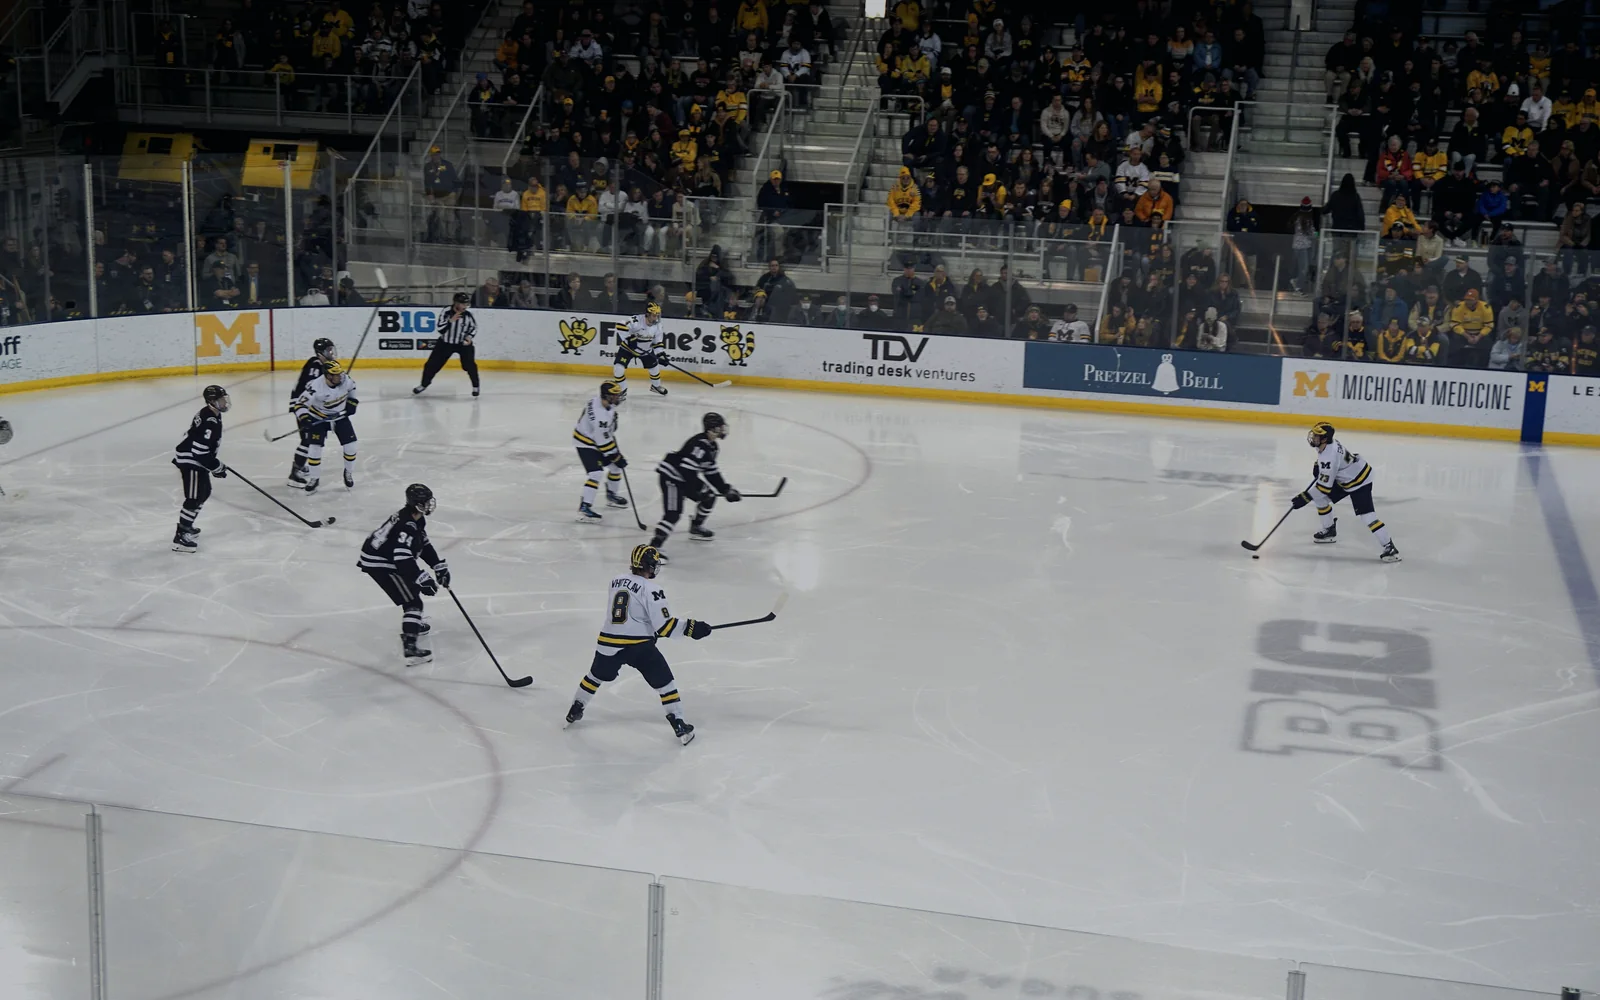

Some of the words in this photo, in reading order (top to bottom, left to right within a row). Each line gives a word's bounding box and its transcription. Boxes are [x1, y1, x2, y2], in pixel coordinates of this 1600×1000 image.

[196, 312, 261, 357] M
[1057, 329, 1075, 341] M
[863, 333, 930, 363] TDV
[600, 350, 618, 358] Pes
[701, 357, 717, 365] Inc.
[822, 361, 874, 377] trading
[877, 363, 912, 378] desk
[915, 368, 976, 382] ventures
[1083, 363, 1151, 385] PRETZEL
[1181, 370, 1223, 390] BELL
[1292, 370, 1331, 398] M
[1528, 380, 1546, 392] M
[1572, 385, 1600, 398] LE
[1342, 374, 1426, 405] MICHIGAN
[1431, 380, 1513, 411] MEDICINE
[203, 428, 212, 440] 3
[1320, 461, 1331, 470] M
[1319, 473, 1330, 483] 73
[397, 531, 414, 548] 34
[611, 578, 642, 594] WHITELAW
[651, 589, 666, 602] M
[611, 589, 631, 625] 8
[661, 607, 670, 618] 8
